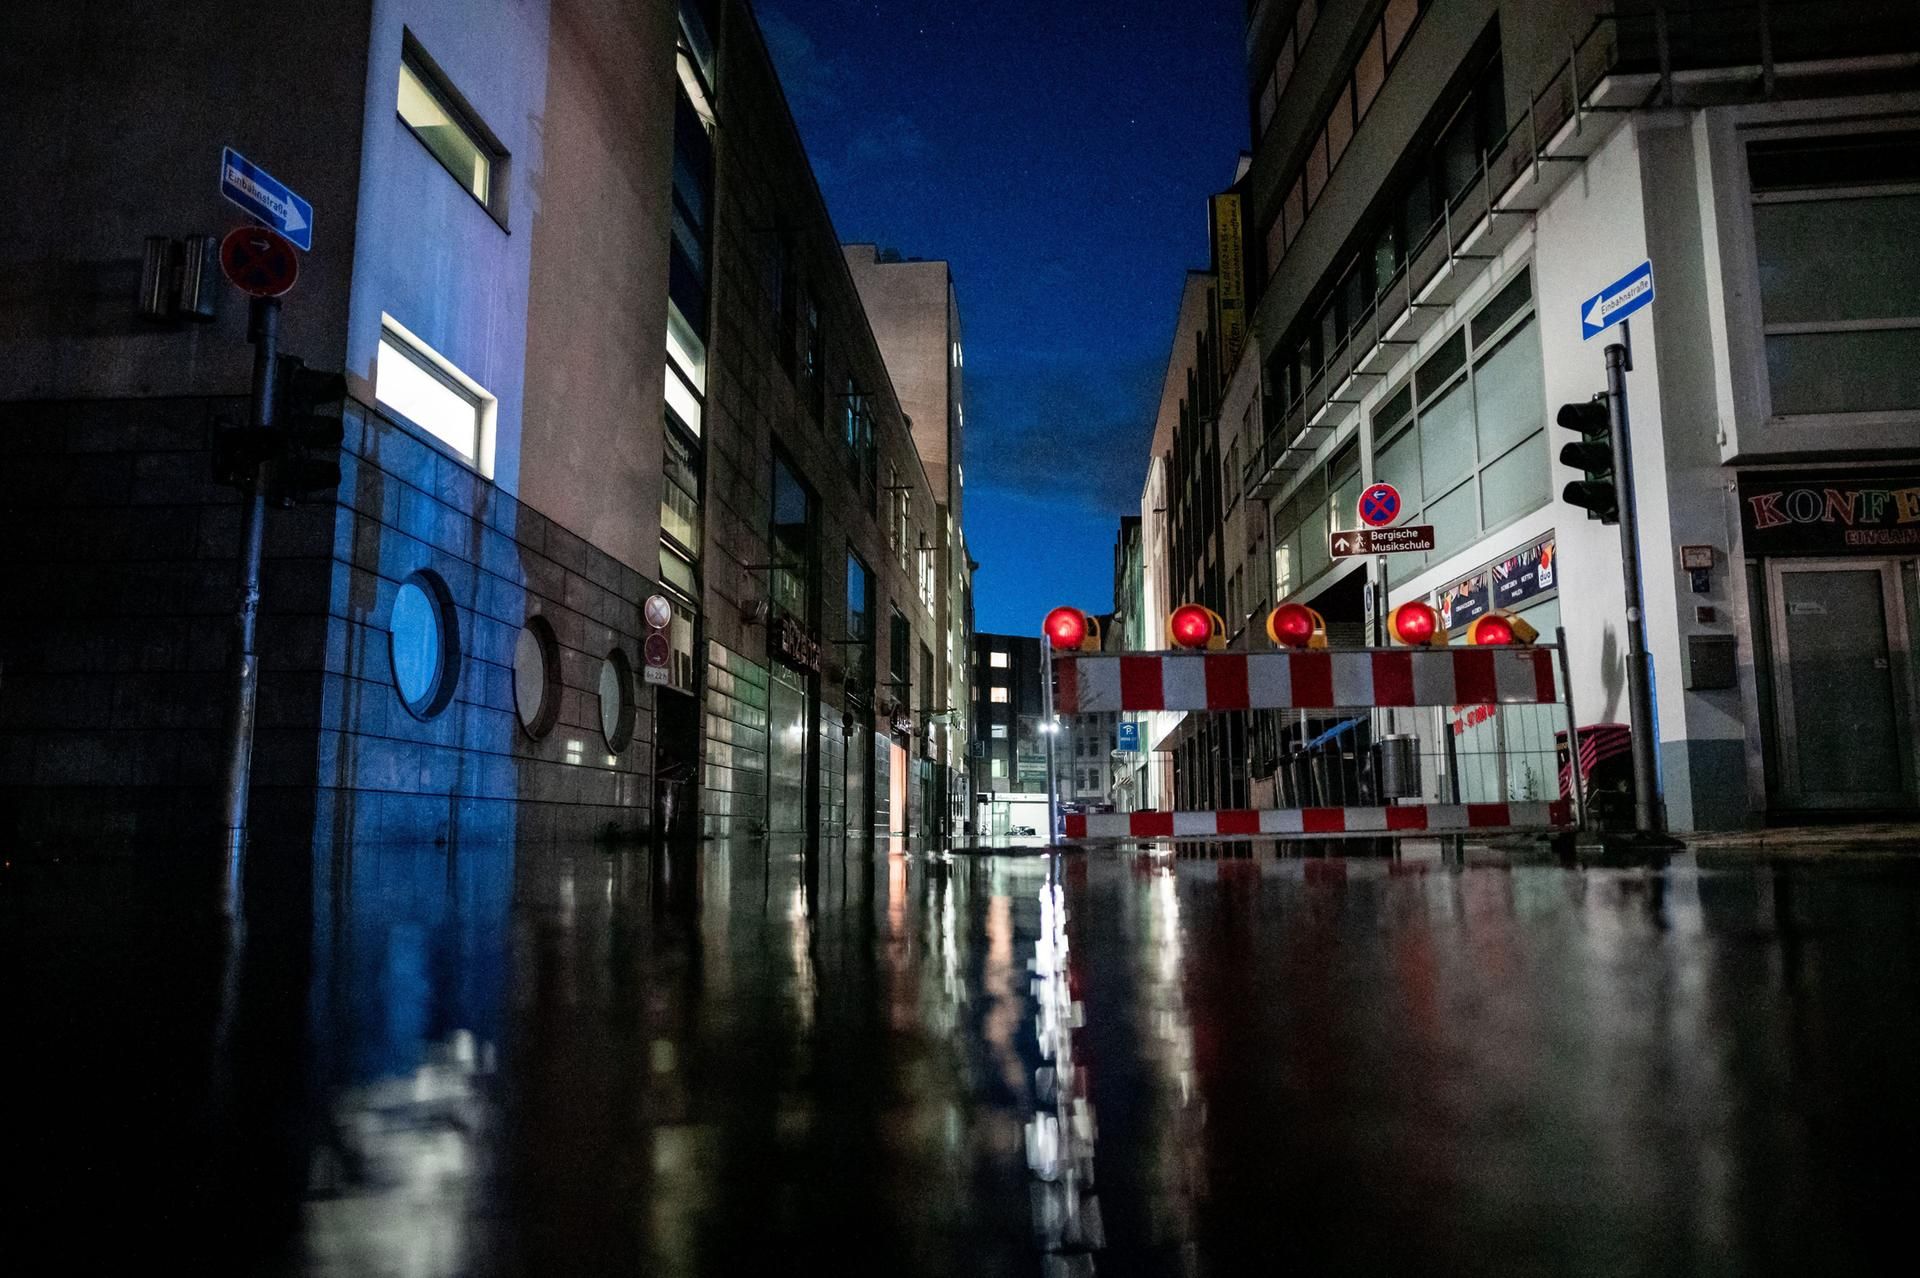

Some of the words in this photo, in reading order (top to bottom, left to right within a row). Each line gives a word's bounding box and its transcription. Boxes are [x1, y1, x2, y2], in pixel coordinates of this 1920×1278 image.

[228, 169, 288, 217] Einbahnstraße
[1601, 280, 1649, 315] Einbahnstraße
[1371, 530, 1418, 541] Bergische
[1845, 529, 1920, 545] EINGAN
[1371, 540, 1430, 552] Musikschule
